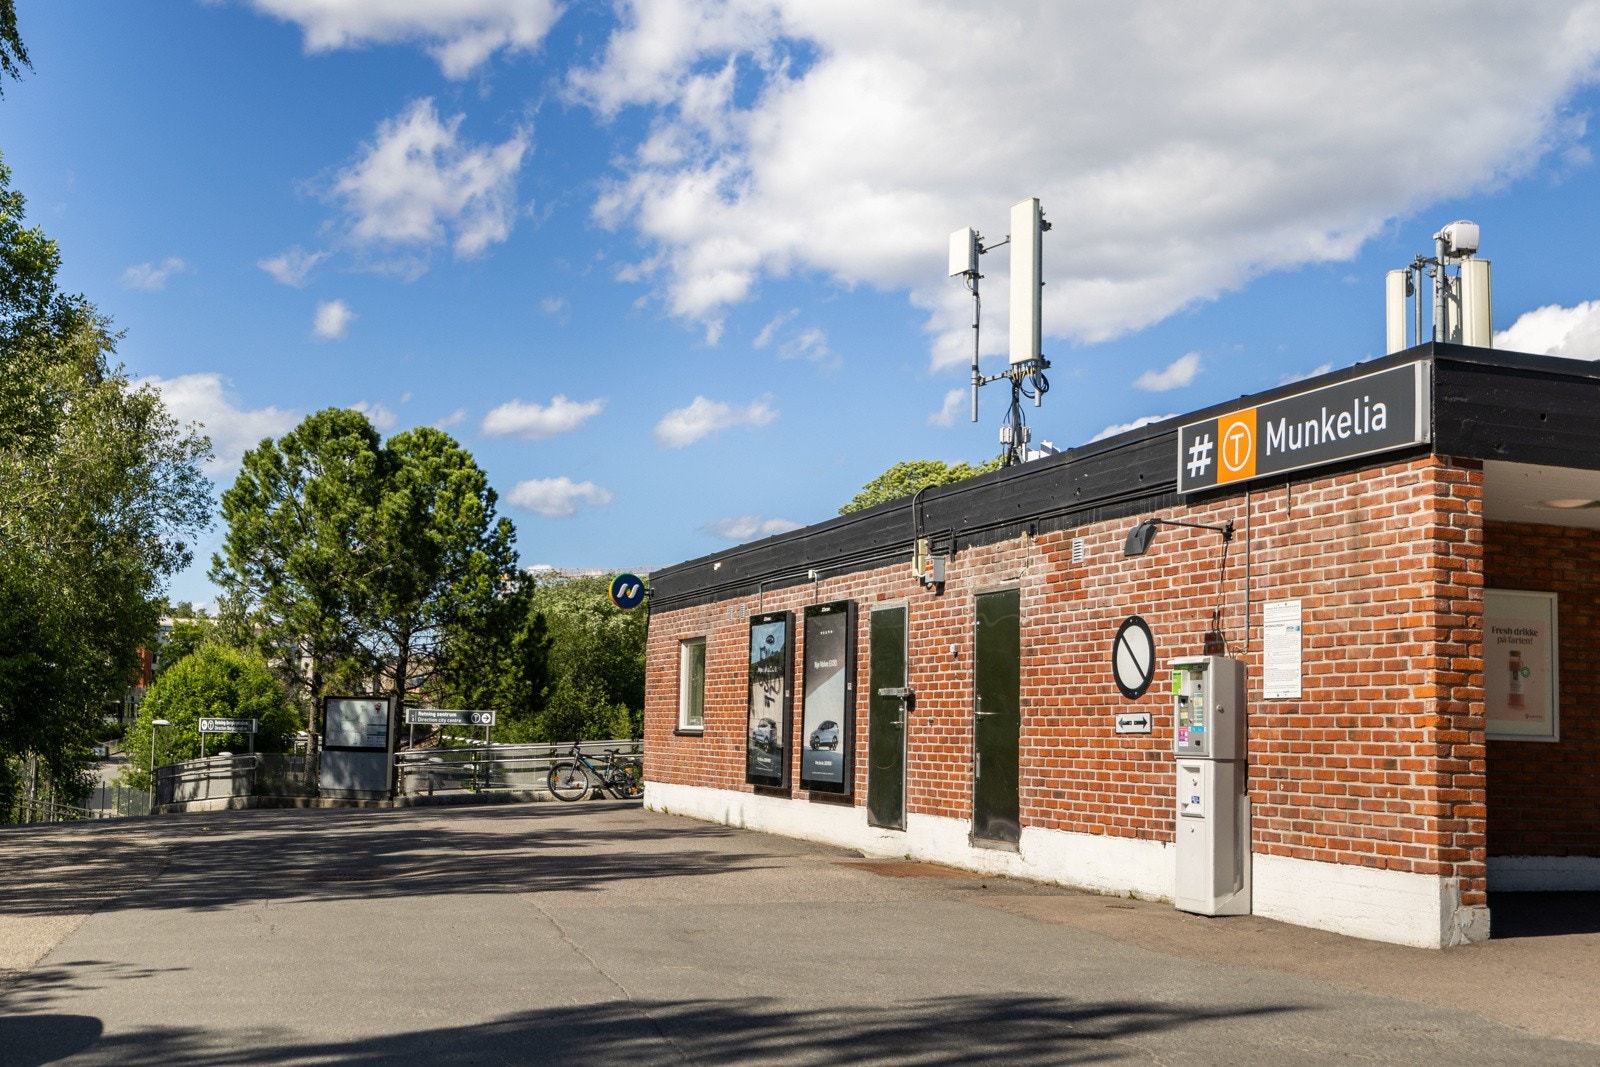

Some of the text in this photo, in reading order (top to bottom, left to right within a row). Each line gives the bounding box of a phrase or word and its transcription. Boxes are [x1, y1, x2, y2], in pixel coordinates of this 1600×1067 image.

[1266, 395, 1387, 456] Munkelia
[1491, 626, 1539, 637] Fresh drikke
